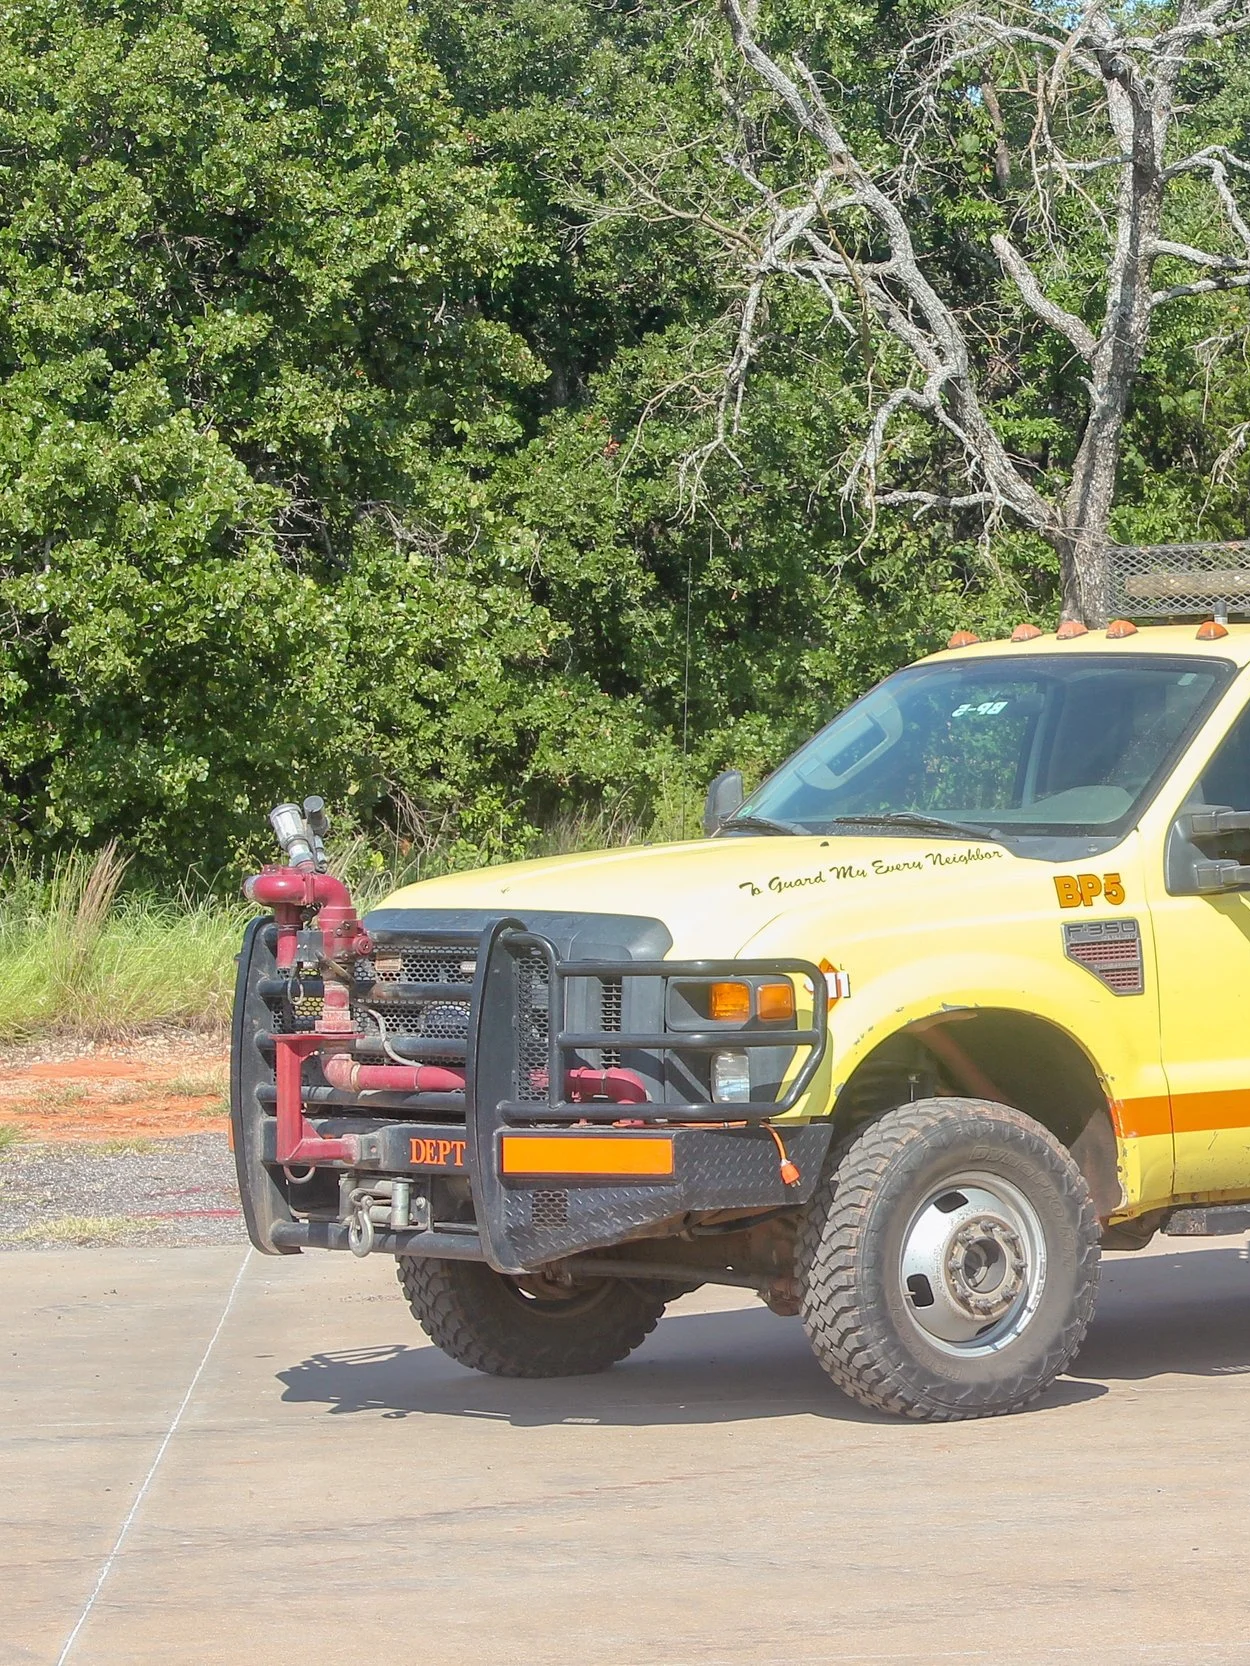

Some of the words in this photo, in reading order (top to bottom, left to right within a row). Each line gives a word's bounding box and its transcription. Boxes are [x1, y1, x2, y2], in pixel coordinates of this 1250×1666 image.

[738, 881, 763, 896] To
[768, 871, 826, 893] Guard
[829, 865, 867, 879] My
[871, 860, 923, 875] Every
[925, 848, 1003, 866] Neighbor
[1053, 873, 1125, 908] BP5
[409, 1138, 467, 1167] DEPT
